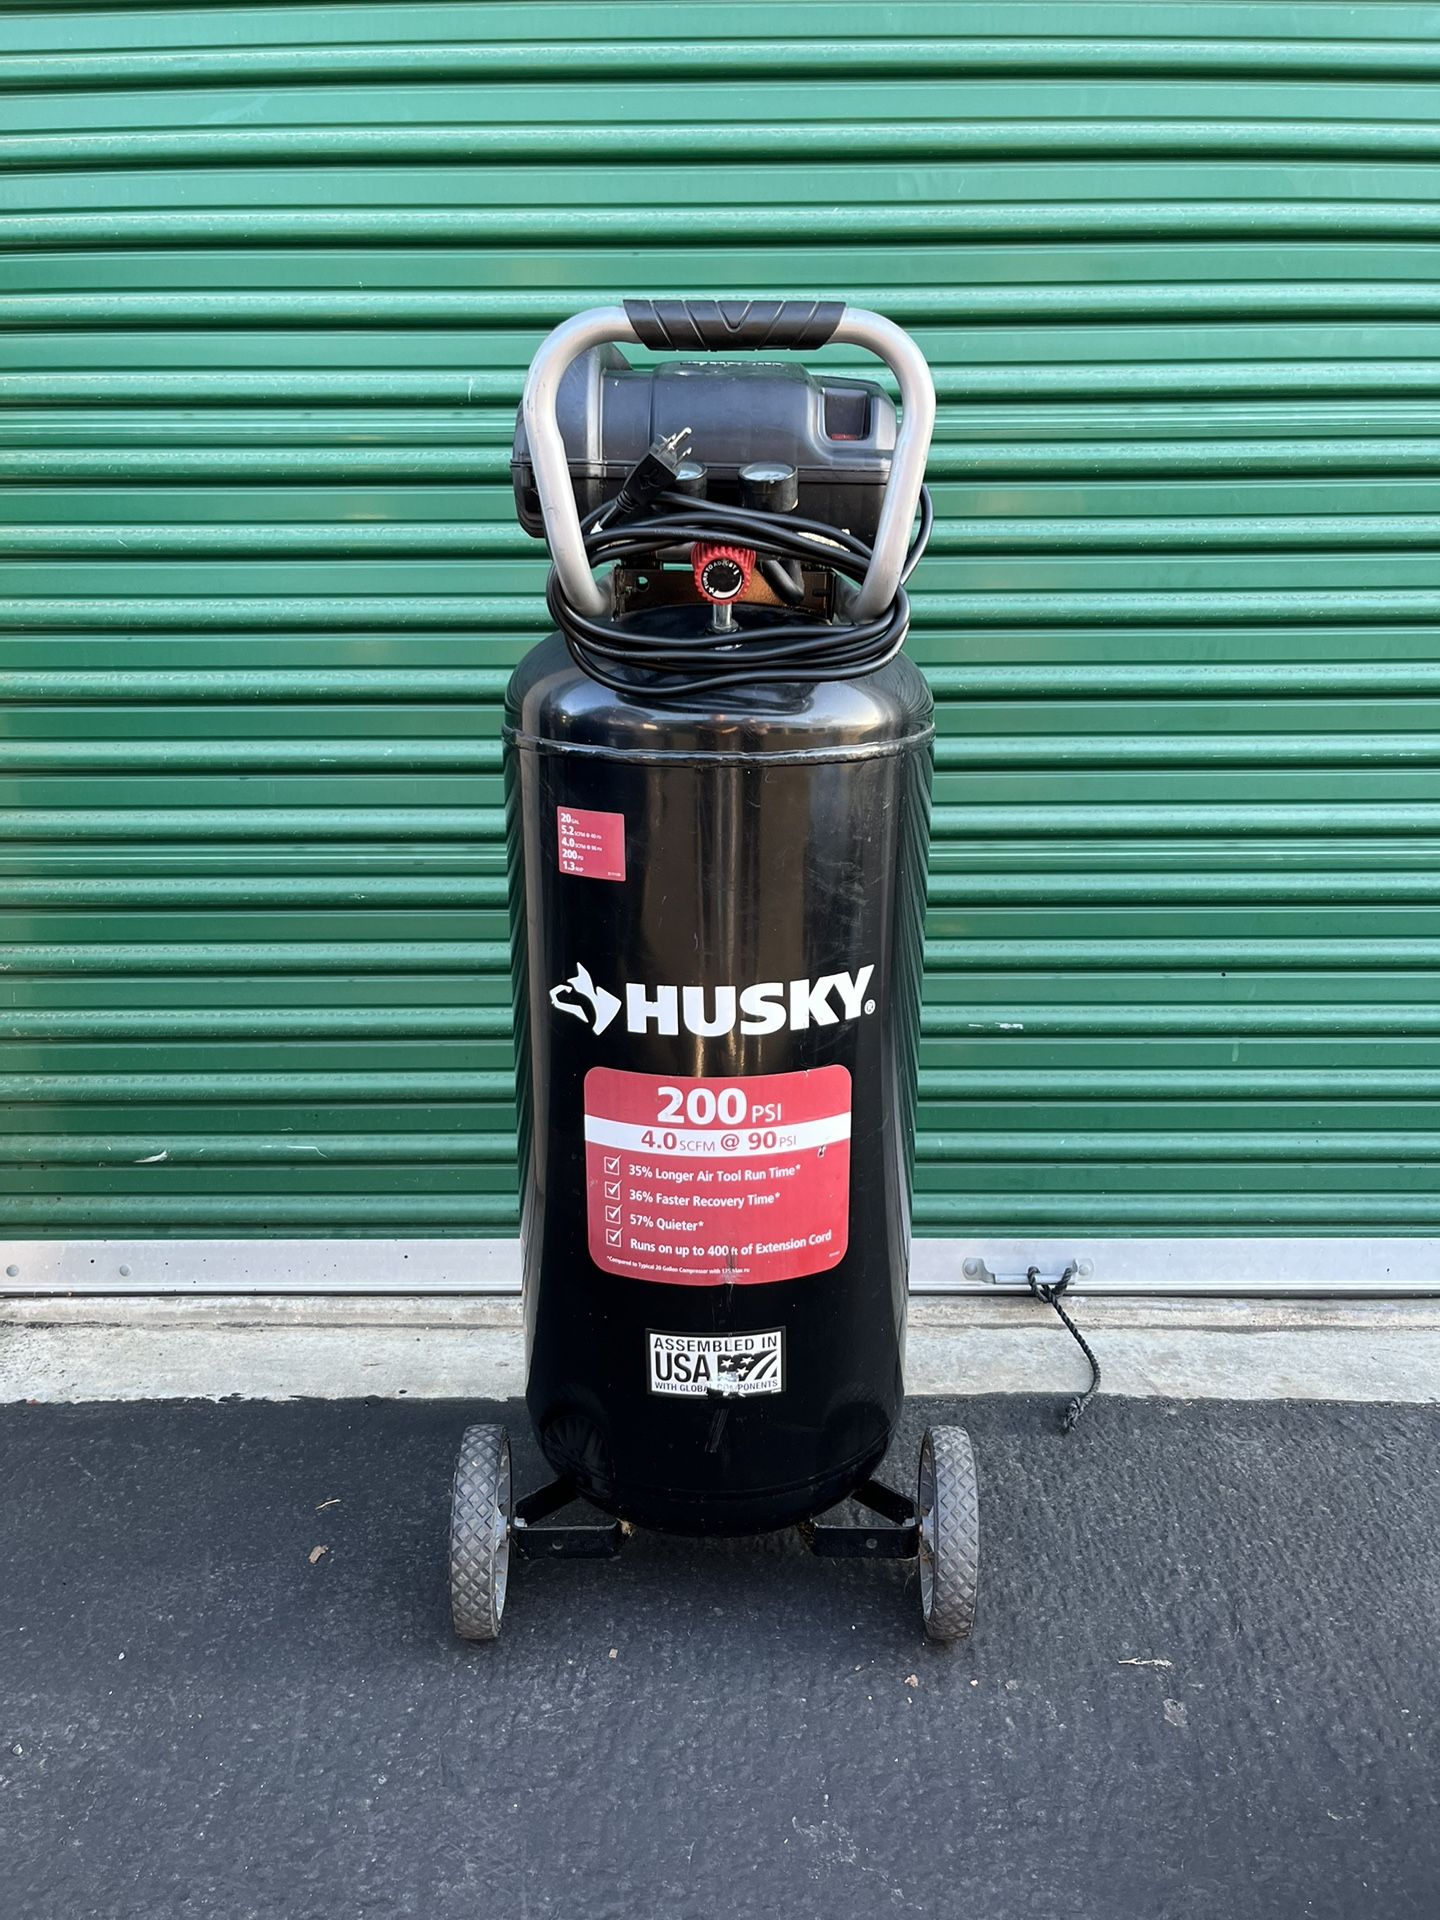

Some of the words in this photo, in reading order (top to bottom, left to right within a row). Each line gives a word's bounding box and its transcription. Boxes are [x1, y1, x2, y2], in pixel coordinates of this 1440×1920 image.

[561, 813, 572, 824] 20
[561, 825, 575, 836] 5.2
[561, 837, 575, 848] 4.0
[562, 848, 578, 860] 200
[563, 861, 576, 871] 1.3
[657, 1086, 748, 1126] 200
[752, 1103, 783, 1124] PSI
[641, 1130, 678, 1151] 4.0
[679, 1139, 716, 1153] SCFM
[720, 1133, 741, 1152] @
[748, 1131, 778, 1151] 90
[779, 1135, 798, 1148] PSI
[628, 1164, 654, 1179] 35%
[655, 1168, 695, 1184] Longer
[697, 1170, 715, 1183] Air
[717, 1169, 742, 1182] Tool
[744, 1170, 767, 1181] Run
[629, 1189, 654, 1204] 36%
[656, 1193, 691, 1206] Faster
[693, 1195, 745, 1210] Recovery
[630, 1213, 655, 1228] 57%
[630, 1238, 656, 1252] Runs
[658, 1244, 673, 1254] on
[675, 1246, 690, 1258] up
[692, 1245, 705, 1257] to
[707, 1245, 730, 1257] 400
[731, 1246, 738, 1256] ft
[741, 1243, 754, 1255] of
[756, 1237, 807, 1254] Extension
[808, 1229, 832, 1246] Cord
[638, 1262, 655, 1271] Typical
[679, 1266, 709, 1275] Compressor
[653, 1337, 755, 1353] ASSEMBLED
[762, 1335, 777, 1349] IN
[655, 1350, 711, 1383] USA
[655, 1382, 677, 1391] WITH
